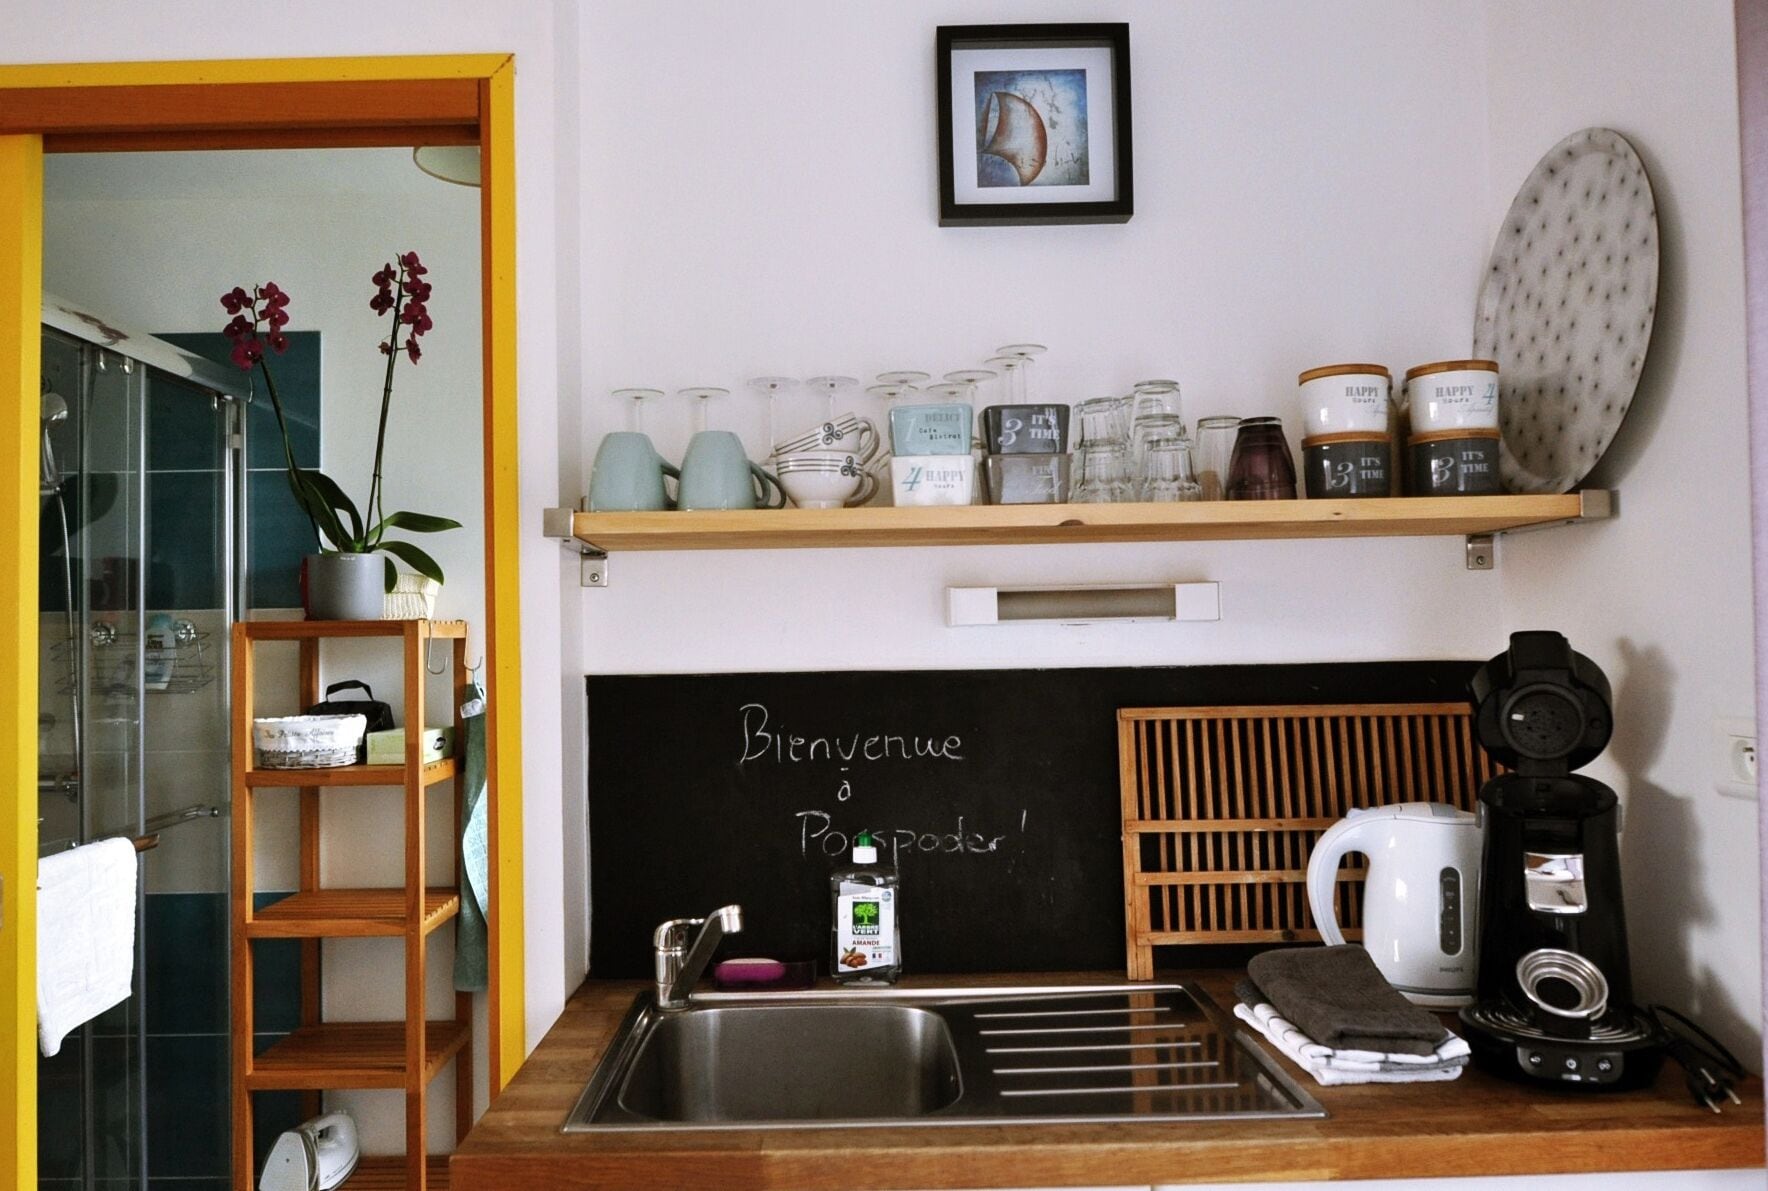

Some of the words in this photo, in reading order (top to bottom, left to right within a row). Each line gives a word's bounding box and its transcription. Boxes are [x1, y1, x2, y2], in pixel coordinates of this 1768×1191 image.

[1346, 386, 1379, 397] HAPPY
[1435, 385, 1474, 398] HAPPY
[1031, 413, 1057, 425] IT'S
[997, 418, 1023, 446] 3
[1029, 428, 1061, 441] TIME
[1360, 457, 1381, 467] IT'S
[1461, 451, 1485, 461] IT'S
[1331, 461, 1354, 488] 3
[1360, 469, 1385, 480] TIME
[1460, 463, 1489, 474] TIME
[902, 466, 923, 491] 4
[925, 470, 965, 482] HAPPY
[739, 703, 965, 764] Bienvenue
